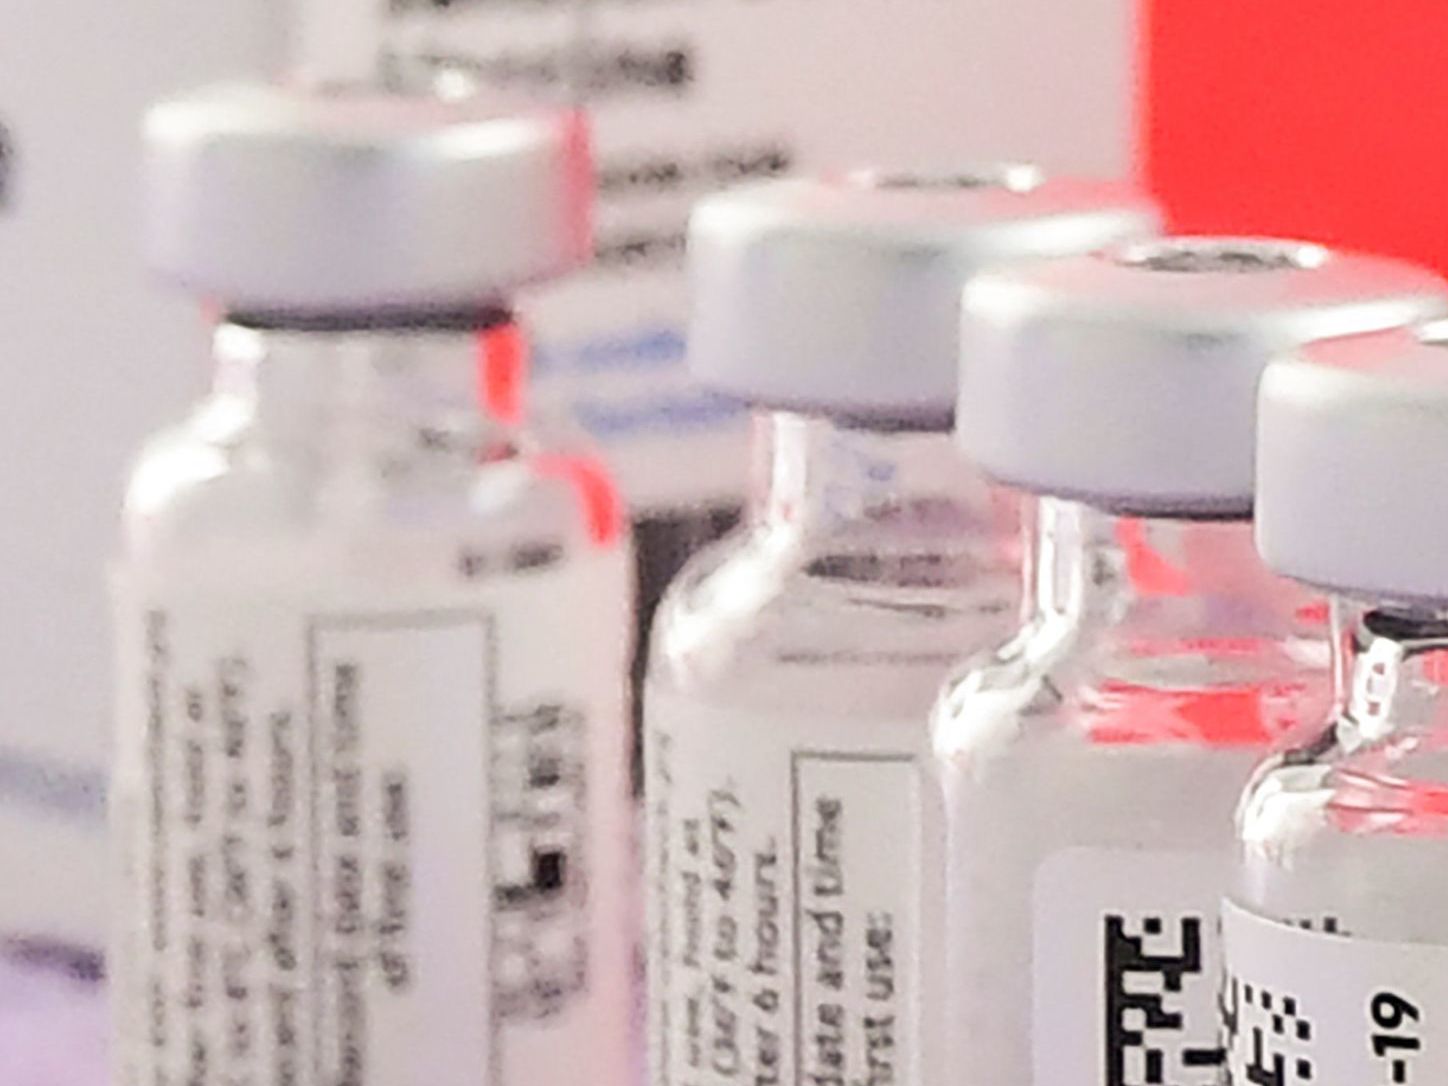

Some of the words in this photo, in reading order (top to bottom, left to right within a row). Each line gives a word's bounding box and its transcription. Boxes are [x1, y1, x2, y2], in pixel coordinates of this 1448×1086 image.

[807, 797, 843, 897] time
[807, 911, 844, 990] and
[752, 989, 780, 1014] 6
